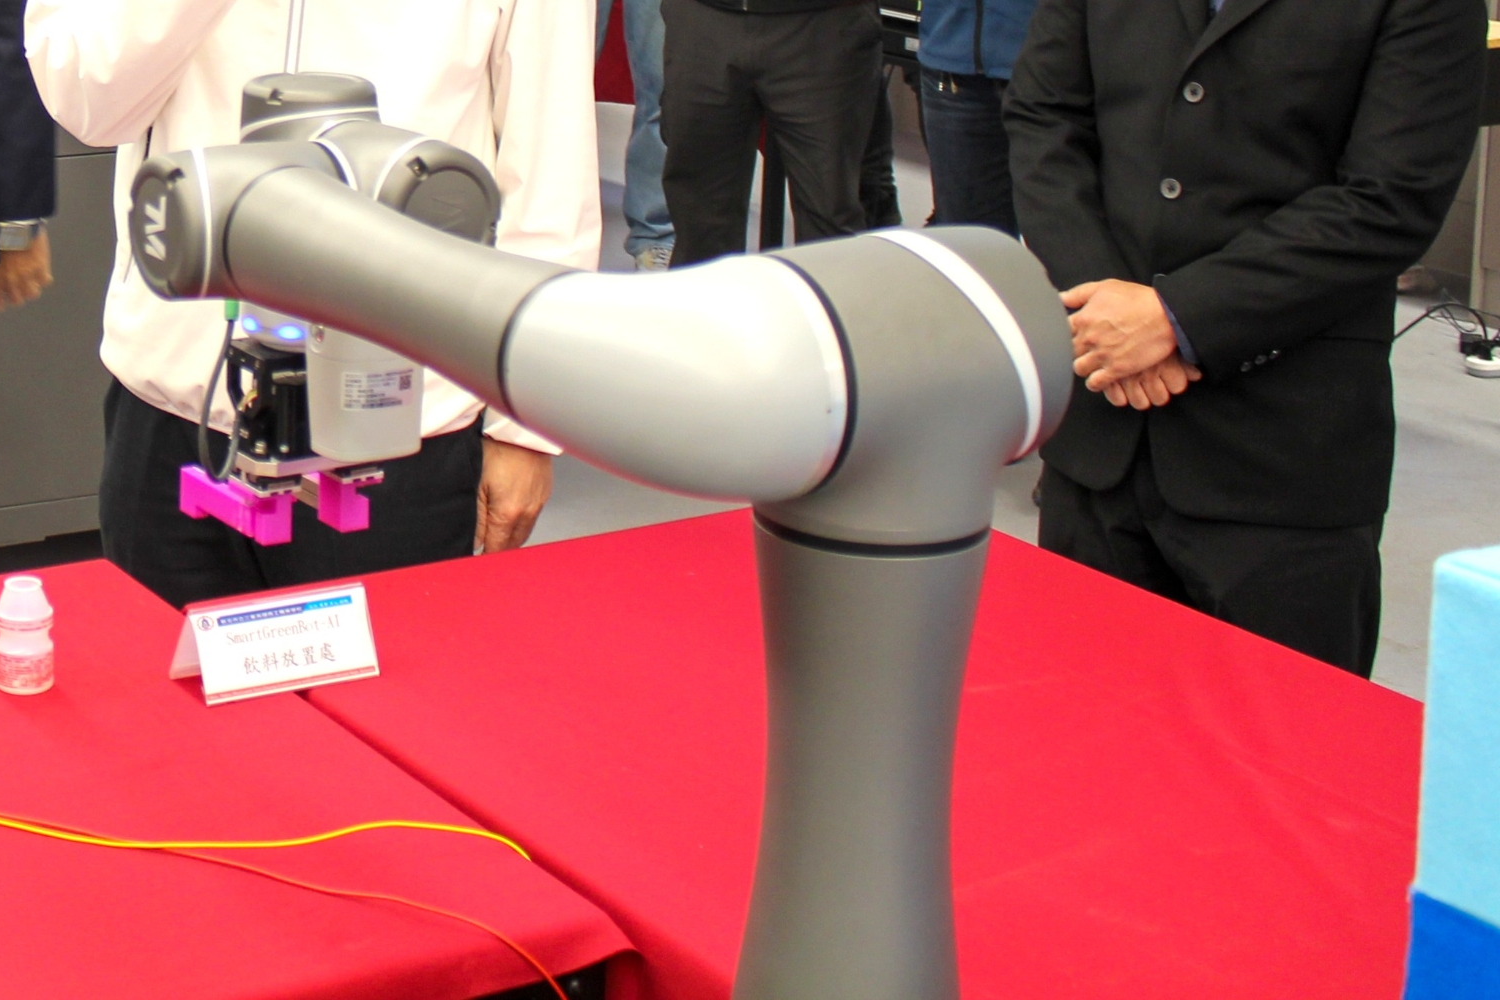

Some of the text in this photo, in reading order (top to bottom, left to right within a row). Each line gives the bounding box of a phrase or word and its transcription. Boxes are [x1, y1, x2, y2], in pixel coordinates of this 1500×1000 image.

[243, 642, 336, 675] 飲料放置處
